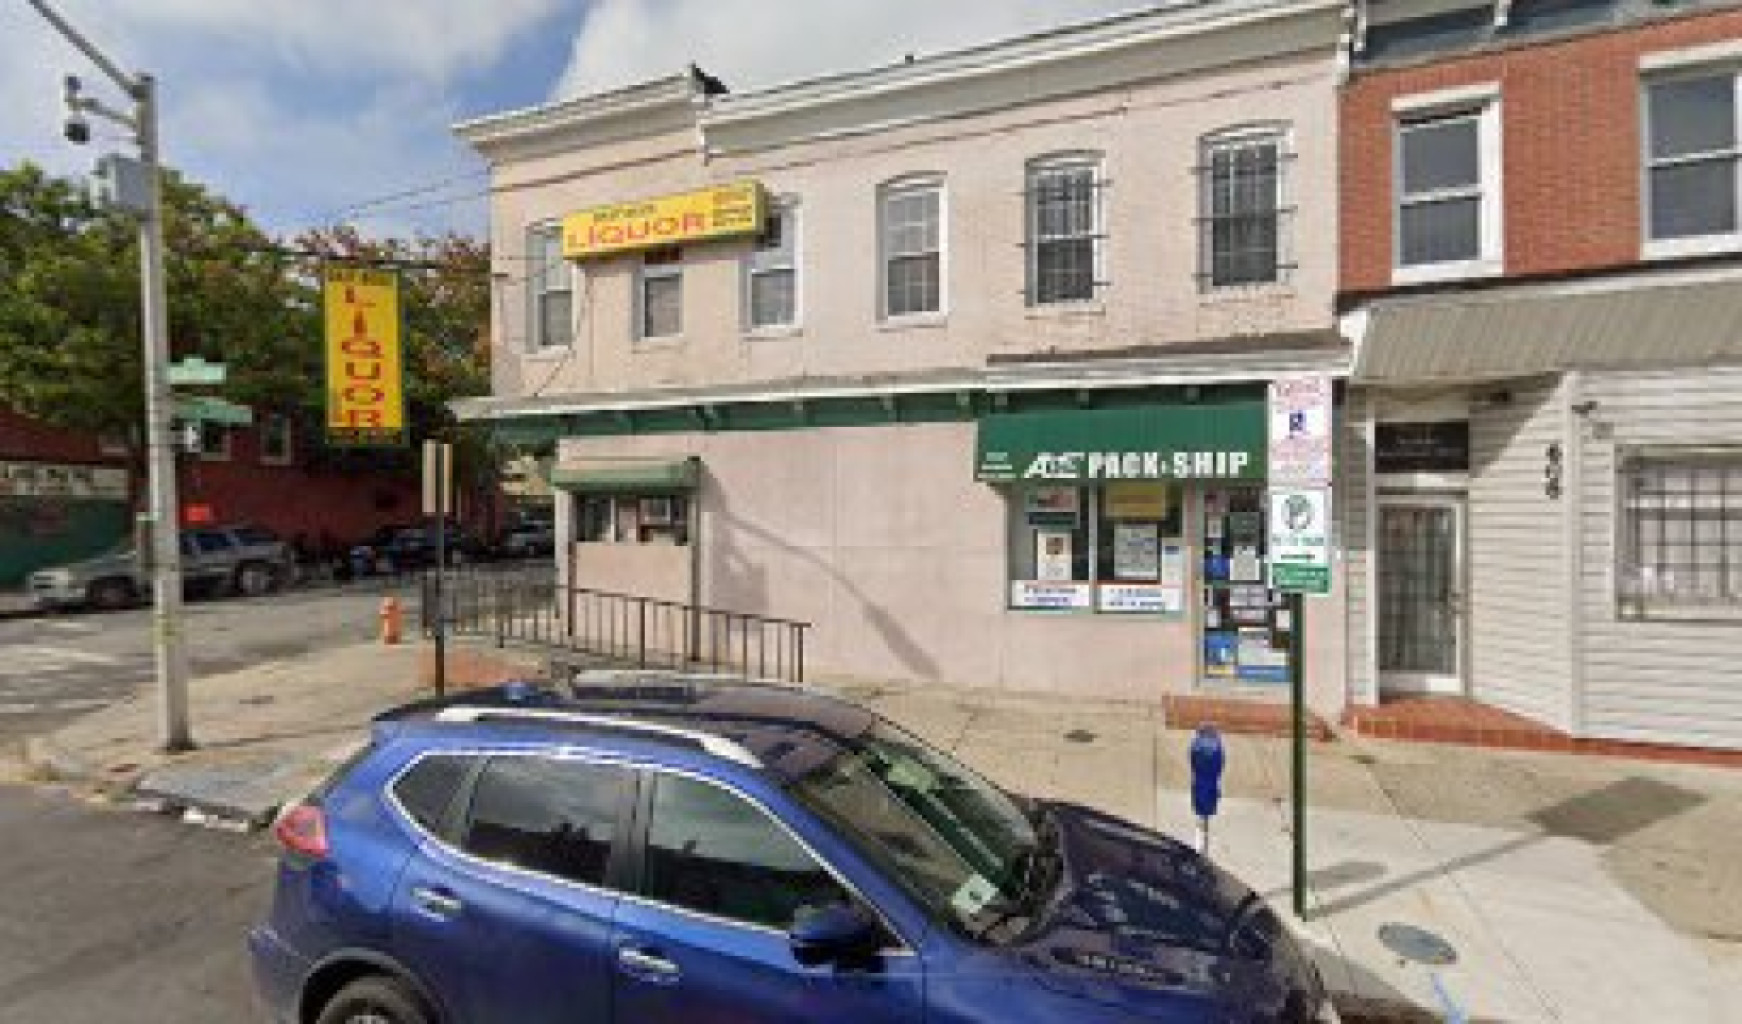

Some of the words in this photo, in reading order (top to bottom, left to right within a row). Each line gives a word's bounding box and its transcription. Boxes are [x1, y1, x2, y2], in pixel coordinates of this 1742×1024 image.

[565, 211, 707, 250] LIQUOR
[341, 286, 385, 430] LIQUOR
[1088, 451, 1158, 479] PACK
[1173, 451, 1248, 479] SHIP
